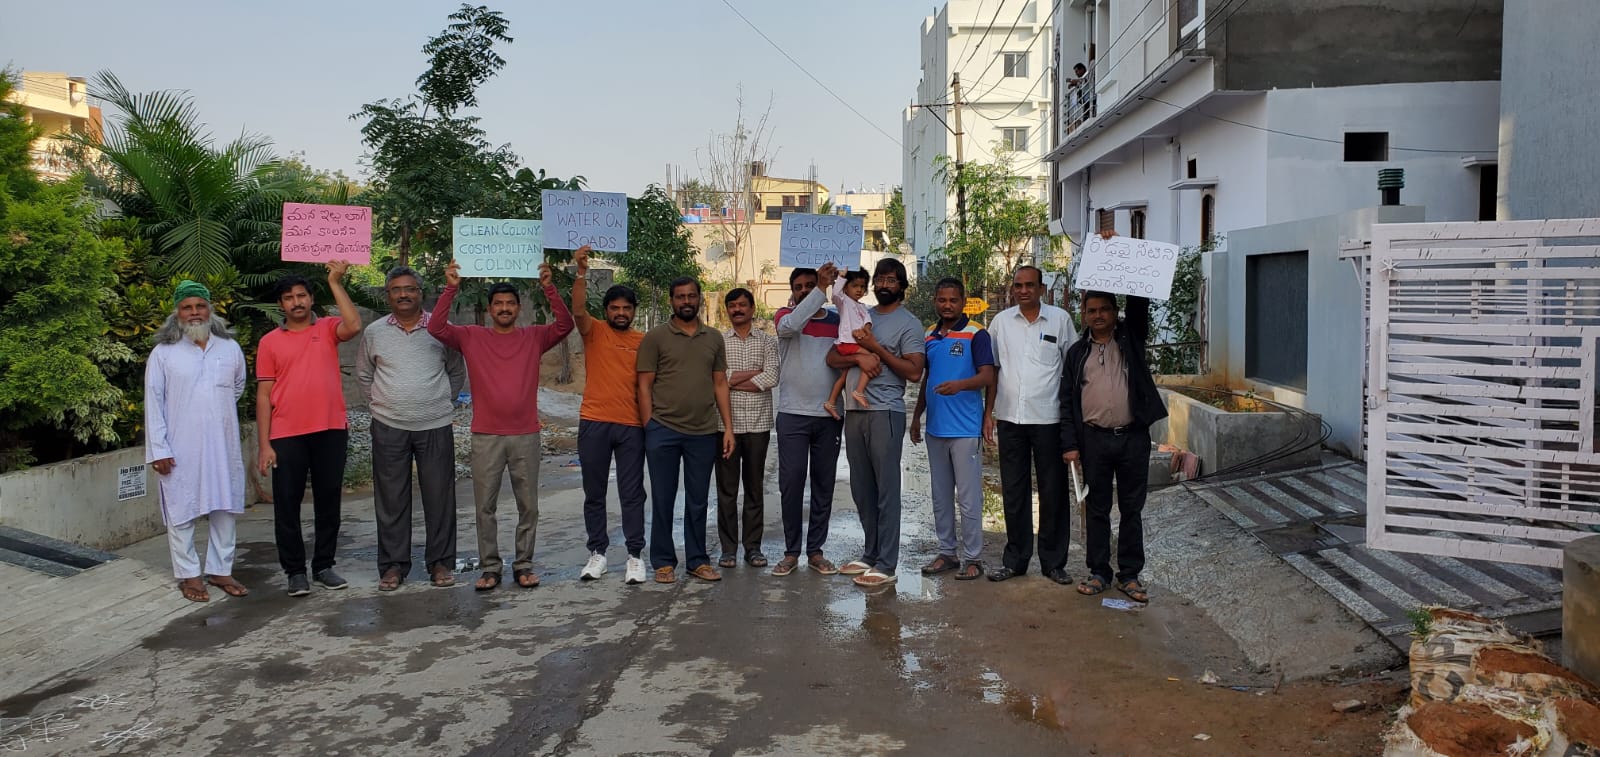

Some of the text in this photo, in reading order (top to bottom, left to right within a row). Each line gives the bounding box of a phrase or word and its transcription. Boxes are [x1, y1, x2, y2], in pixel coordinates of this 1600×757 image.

[583, 194, 620, 208] DRAIN
[287, 207, 316, 221] మన
[557, 212, 623, 229] WATER ON
[286, 225, 312, 236] మన
[459, 221, 540, 237] CLEAN COLONY
[811, 218, 833, 234] KEEP
[836, 220, 860, 235] OUR
[568, 230, 617, 249] ROADS
[789, 236, 855, 253] COLONY
[459, 243, 542, 255] COSMOPOLITAN
[474, 258, 533, 271] COLONY
[795, 251, 844, 266] CLEAN
